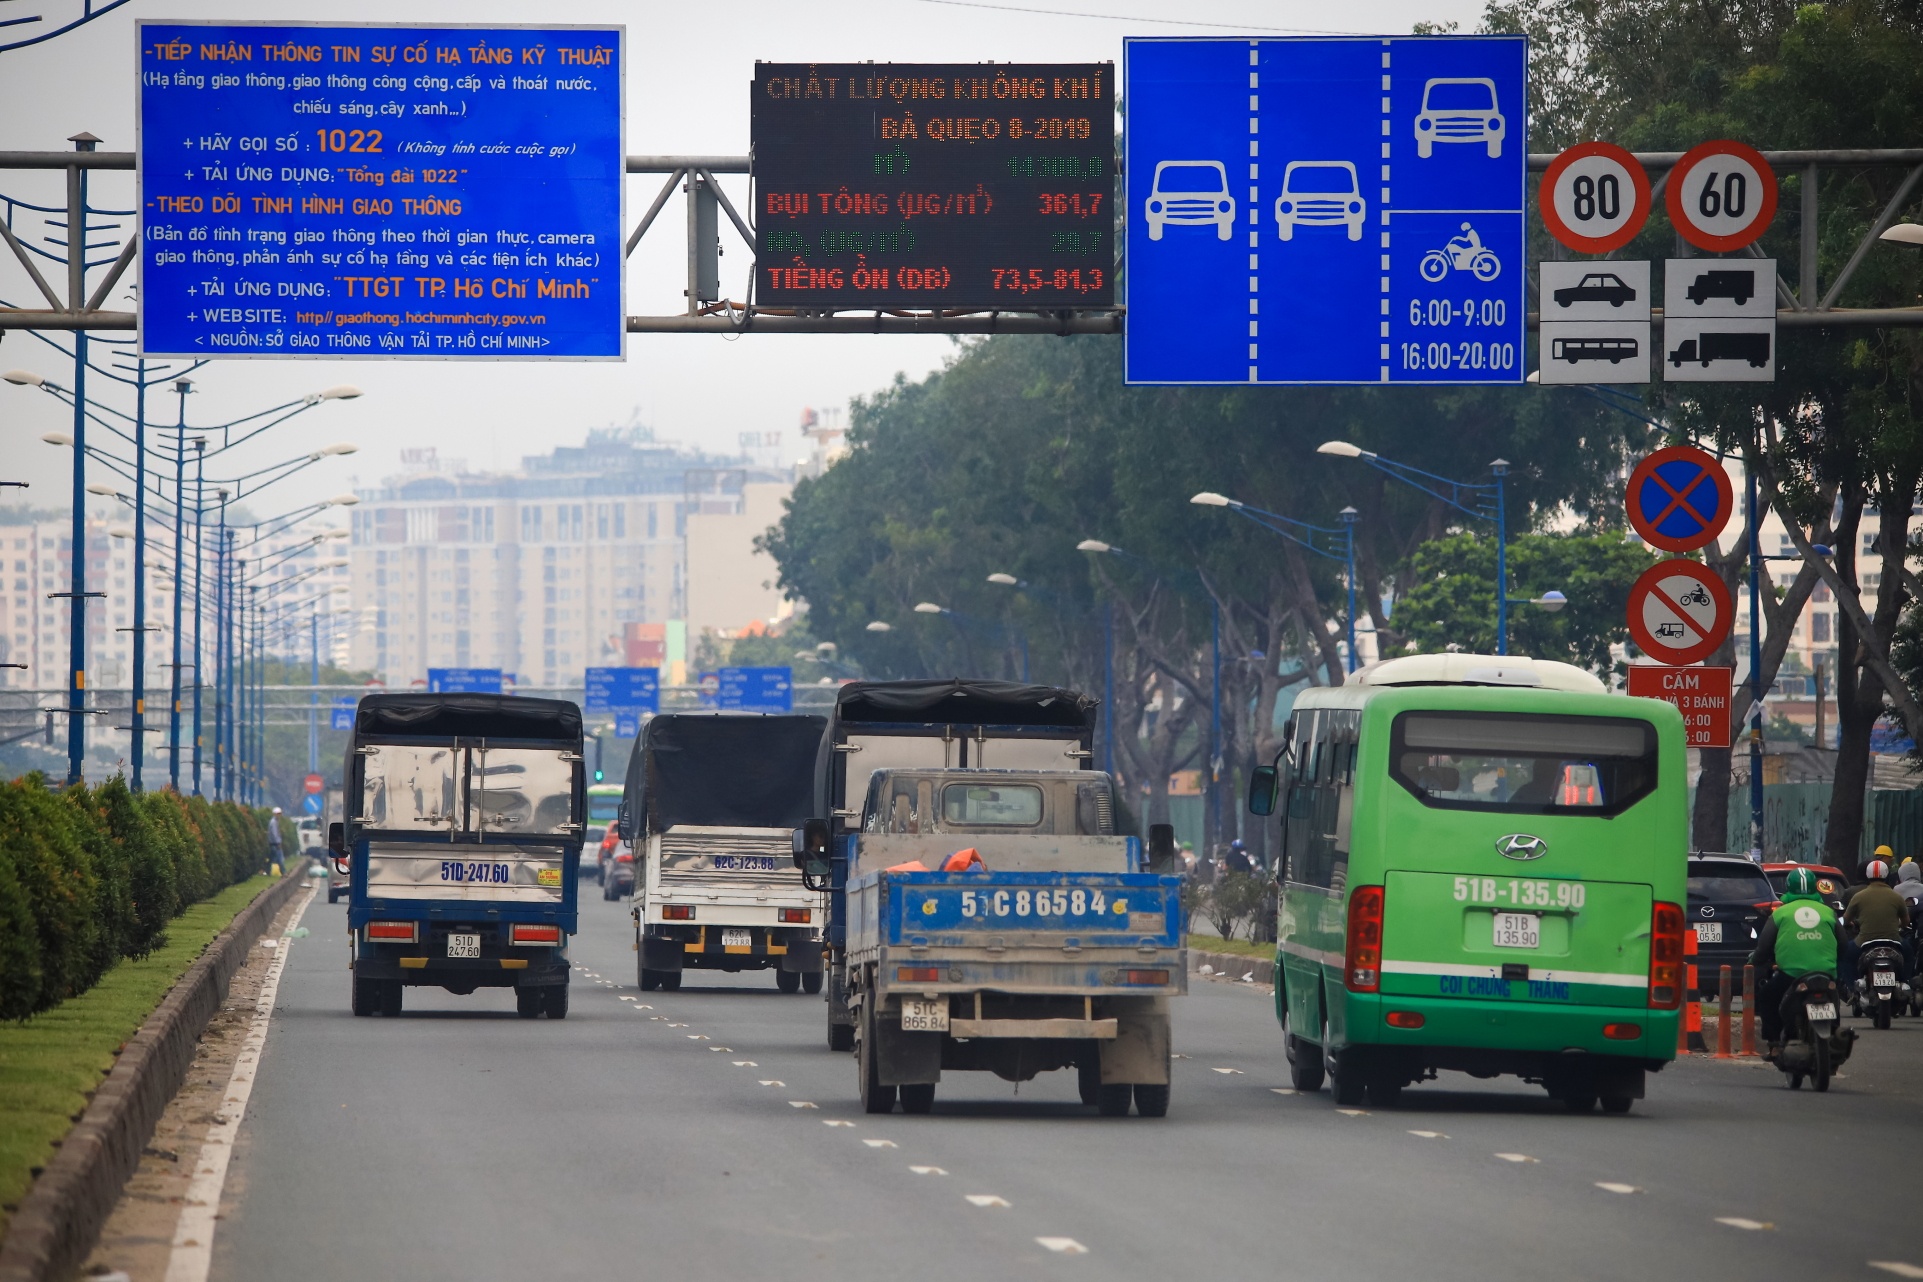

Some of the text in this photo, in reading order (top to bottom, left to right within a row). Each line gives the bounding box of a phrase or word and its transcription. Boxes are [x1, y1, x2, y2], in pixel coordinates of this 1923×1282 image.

[200, 41, 251, 64] NHẬN
[262, 42, 322, 62] THÔNG
[331, 46, 360, 62] TIN
[371, 46, 396, 66] SỰ
[403, 40, 428, 64] CỐ
[436, 47, 461, 67] HẠ
[468, 40, 513, 64] TẦNG
[522, 44, 546, 64] KỸ
[558, 45, 613, 68] THUẬT
[143, 70, 169, 89] (Hạ
[174, 69, 204, 89] tầng
[211, 73, 240, 89] giao
[327, 74, 366, 91] thông
[373, 75, 407, 92] công
[489, 74, 506, 89] và
[513, 74, 548, 90] thoát
[556, 76, 597, 91] nước,
[767, 64, 1103, 103] CHẤT LƯỢNG KHÔNG KHÍ
[293, 97, 331, 114] chiếu
[881, 111, 1091, 144] BÀ QUẸO 8-2019
[200, 132, 232, 150] HÃY
[239, 137, 267, 155] GỌI
[275, 131, 299, 151] SỐ
[317, 129, 383, 153] 1022
[398, 141, 446, 156] (Không
[452, 140, 475, 154] tính
[480, 141, 510, 154] cước
[515, 143, 544, 157] cuộc
[202, 160, 228, 179] TẢI
[236, 163, 272, 182] ỨNG
[281, 168, 335, 189] DỤNG:
[391, 167, 414, 183] đài
[1007, 156, 1103, 181] 14300,0
[212, 192, 240, 212] DÕI
[252, 193, 292, 213] TÌNH
[302, 193, 343, 214] HÌNH
[352, 199, 393, 215] GIAO
[401, 195, 462, 215] THÔNG
[767, 193, 809, 218] BỤI
[1039, 193, 1103, 218] 361,7
[1573, 174, 1620, 221] 80
[1699, 172, 1746, 218] 60
[147, 225, 183, 241] (Bản
[188, 226, 208, 241] đồ
[214, 226, 241, 241] tình
[248, 228, 286, 245] trạng
[294, 229, 325, 246] giao
[332, 228, 375, 245] thông
[382, 229, 415, 243] theo
[422, 227, 450, 243] thời
[457, 229, 488, 247] gian
[1052, 232, 1103, 256] 29,7
[155, 249, 186, 267] giao
[287, 249, 313, 264] ánh
[322, 252, 341, 267] sự
[347, 248, 364, 264] cố
[370, 251, 388, 268] hạ
[397, 249, 429, 268] tầng
[436, 250, 453, 265] và
[460, 252, 486, 265] các
[493, 252, 519, 269] tiện
[525, 248, 547, 266] ích
[556, 252, 600, 267] khác)
[768, 254, 1103, 294] TIẾNG ỒN (DB) 73,5-81,3
[201, 277, 225, 296] TẢI
[235, 278, 271, 297] ỨNG
[278, 283, 331, 300] DỤNG:
[454, 277, 484, 298] Hồ
[491, 277, 529, 298] Chí
[203, 309, 286, 323] WEBSITE:
[1409, 299, 1506, 327] 6:00-9:00
[290, 331, 320, 347] GIAO
[327, 331, 371, 348] THÔNG
[379, 332, 404, 350] VẬN
[411, 331, 430, 348] TẢI
[481, 332, 502, 348] CHÍ
[1401, 341, 1514, 370] 16:00-20:00
[1662, 669, 1699, 690] CẤM
[1682, 696, 1690, 708] 3
[1693, 693, 1725, 708] BÁNH
[441, 861, 509, 884] 51D-247.60
[714, 855, 774, 871] 62C-123.88
[1453, 876, 1586, 908] 51B-135.90
[1504, 916, 1528, 931] 51B
[1796, 930, 1822, 940] Grab
[455, 935, 473, 947] 51D
[1496, 930, 1537, 946] 135.90
[448, 946, 480, 958] 247.60
[1440, 975, 1462, 994] COI
[913, 1002, 937, 1016] 51C
